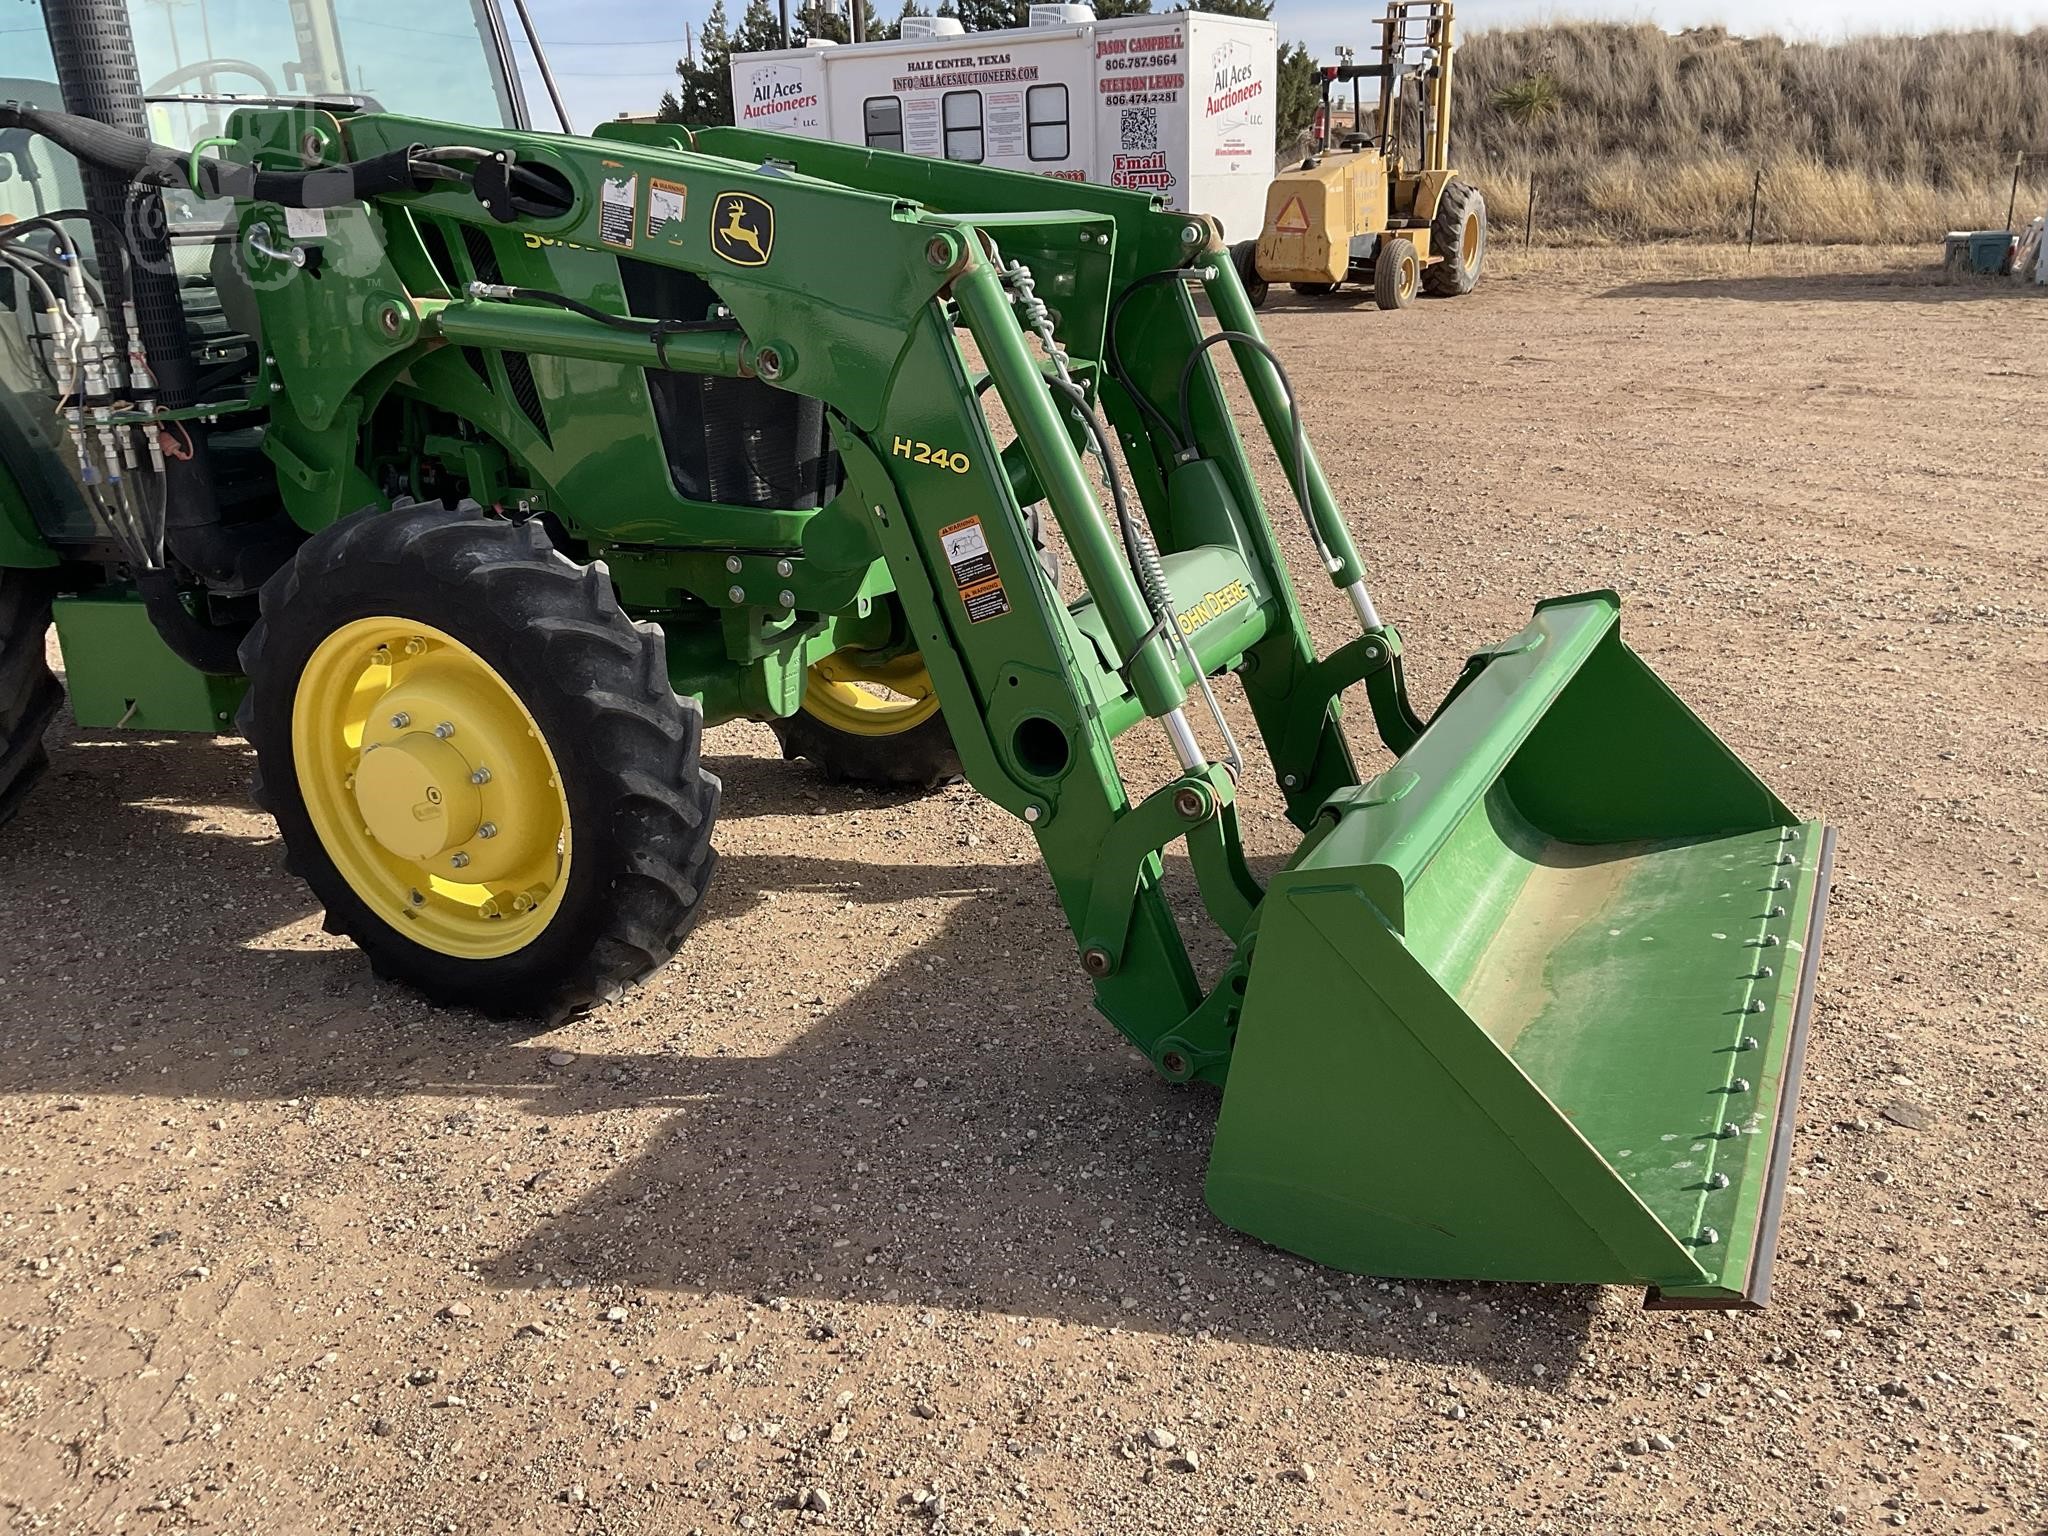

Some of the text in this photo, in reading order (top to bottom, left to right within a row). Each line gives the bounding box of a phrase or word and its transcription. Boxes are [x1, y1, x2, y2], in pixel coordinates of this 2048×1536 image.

[1096, 34, 1184, 59] JASON CAMPBELL
[907, 53, 1011, 72] HALE CENTER, TEXAS
[1105, 54, 1177, 71] 806.787.9664
[1100, 73, 1185, 94] STETSON LEWIS
[1214, 64, 1252, 93] All Aces
[753, 82, 802, 102] All Aces
[1105, 91, 1177, 106] 806.474.2281
[1205, 80, 1262, 118] Auctioneers
[743, 94, 817, 119] Auctioneers
[1114, 152, 1165, 170] Email
[659, 183, 685, 194] WARNING
[1112, 172, 1176, 190] Signup.
[892, 435, 970, 474] H240
[948, 518, 975, 532] WARNING
[971, 582, 999, 596] WARNING
[1173, 579, 1249, 643] OHN DEERE
